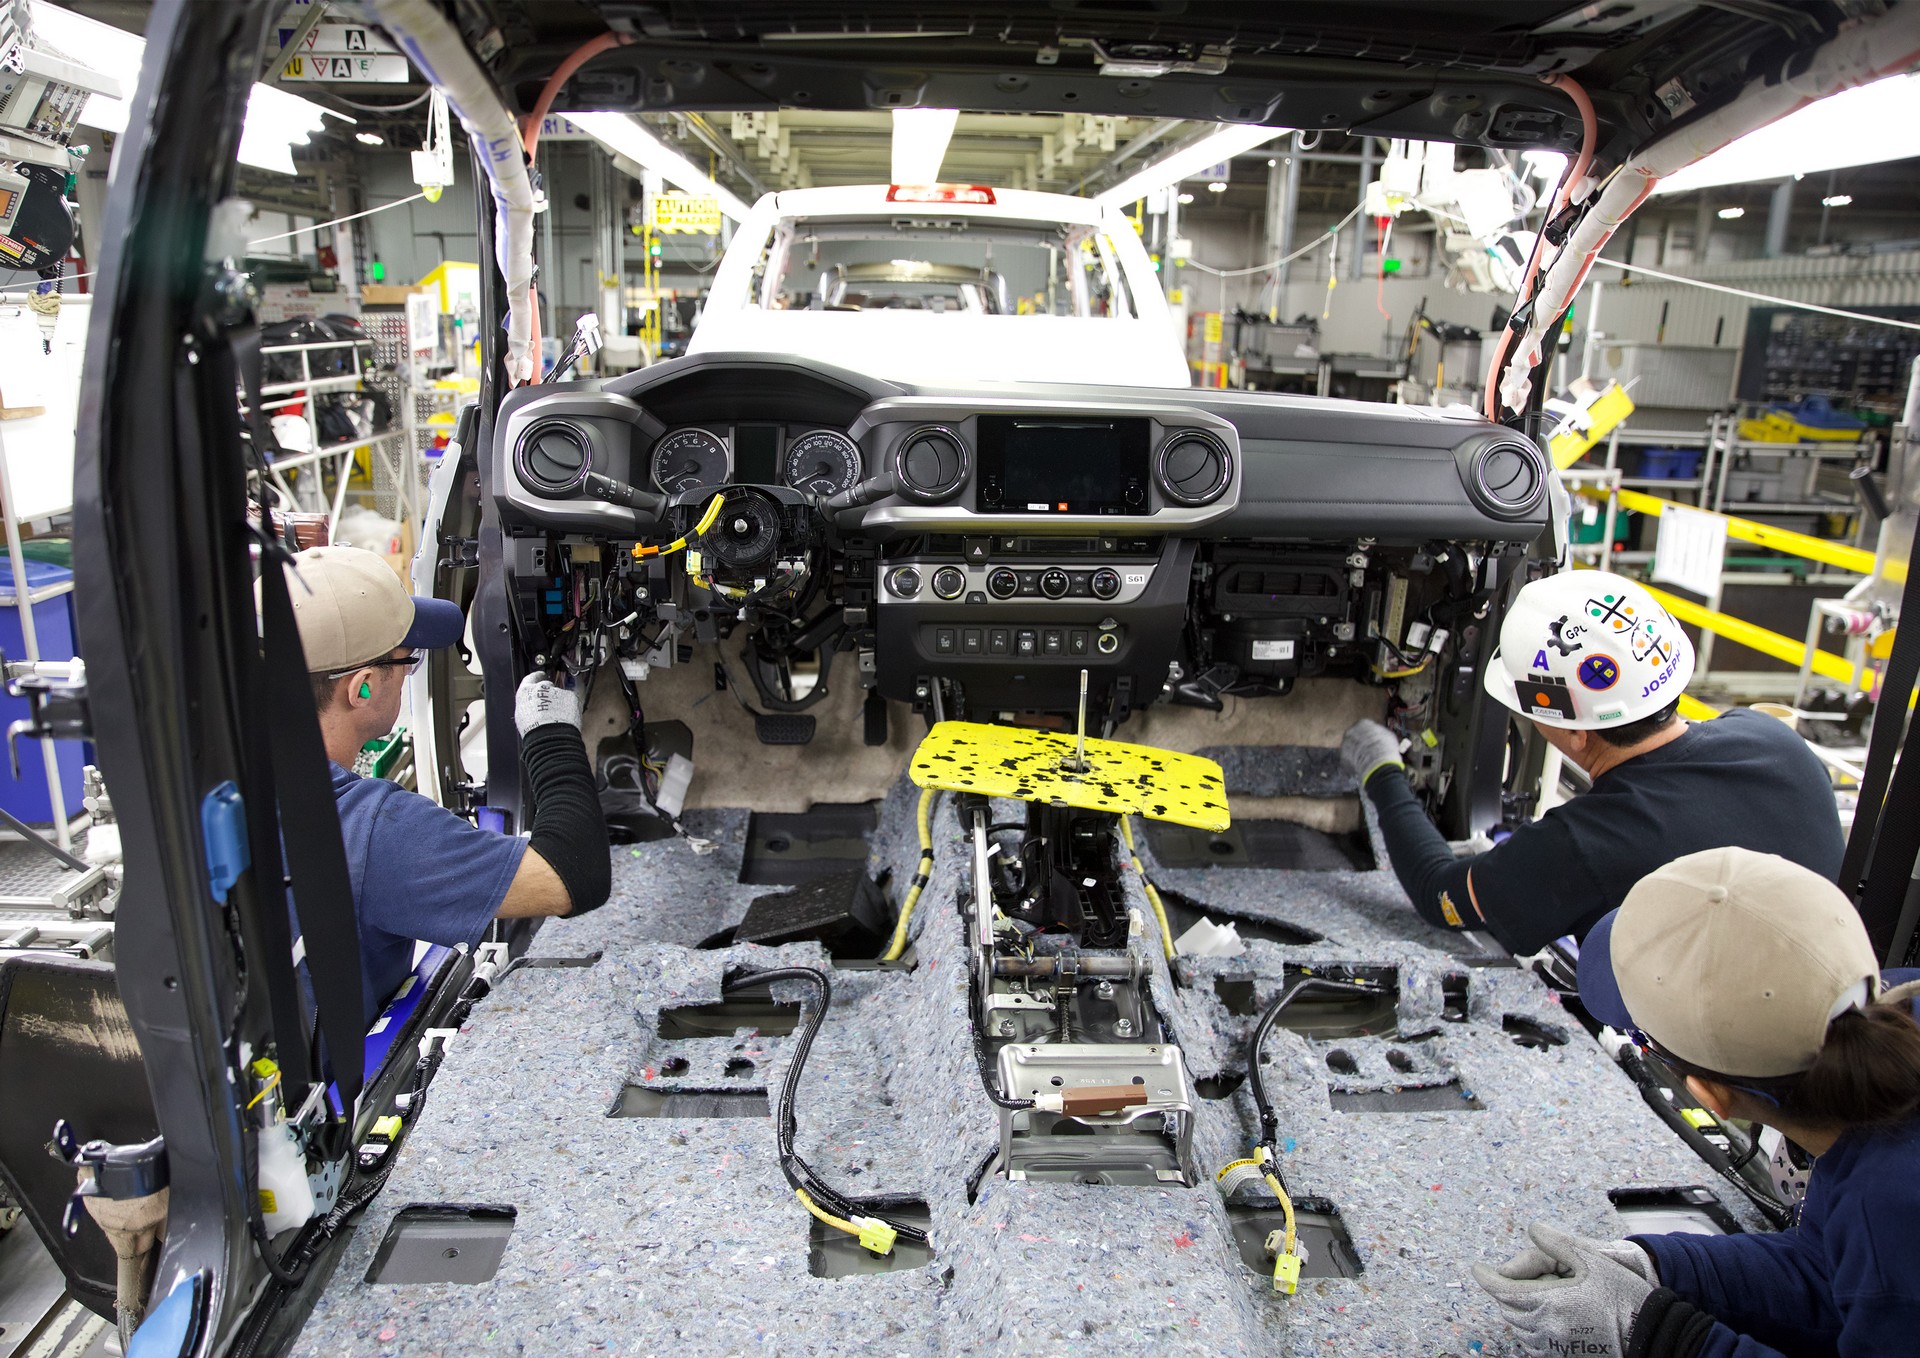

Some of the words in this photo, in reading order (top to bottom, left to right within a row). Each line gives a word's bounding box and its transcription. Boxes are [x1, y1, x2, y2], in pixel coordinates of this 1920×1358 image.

[1566, 625, 1587, 640] GPL
[1532, 650, 1550, 671] A
[1593, 660, 1603, 669] A
[1604, 668, 1614, 679] B
[537, 684, 552, 712] HyFle
[1570, 1327, 1594, 1336] 11-727
[1549, 1338, 1609, 1357] HyFlex
